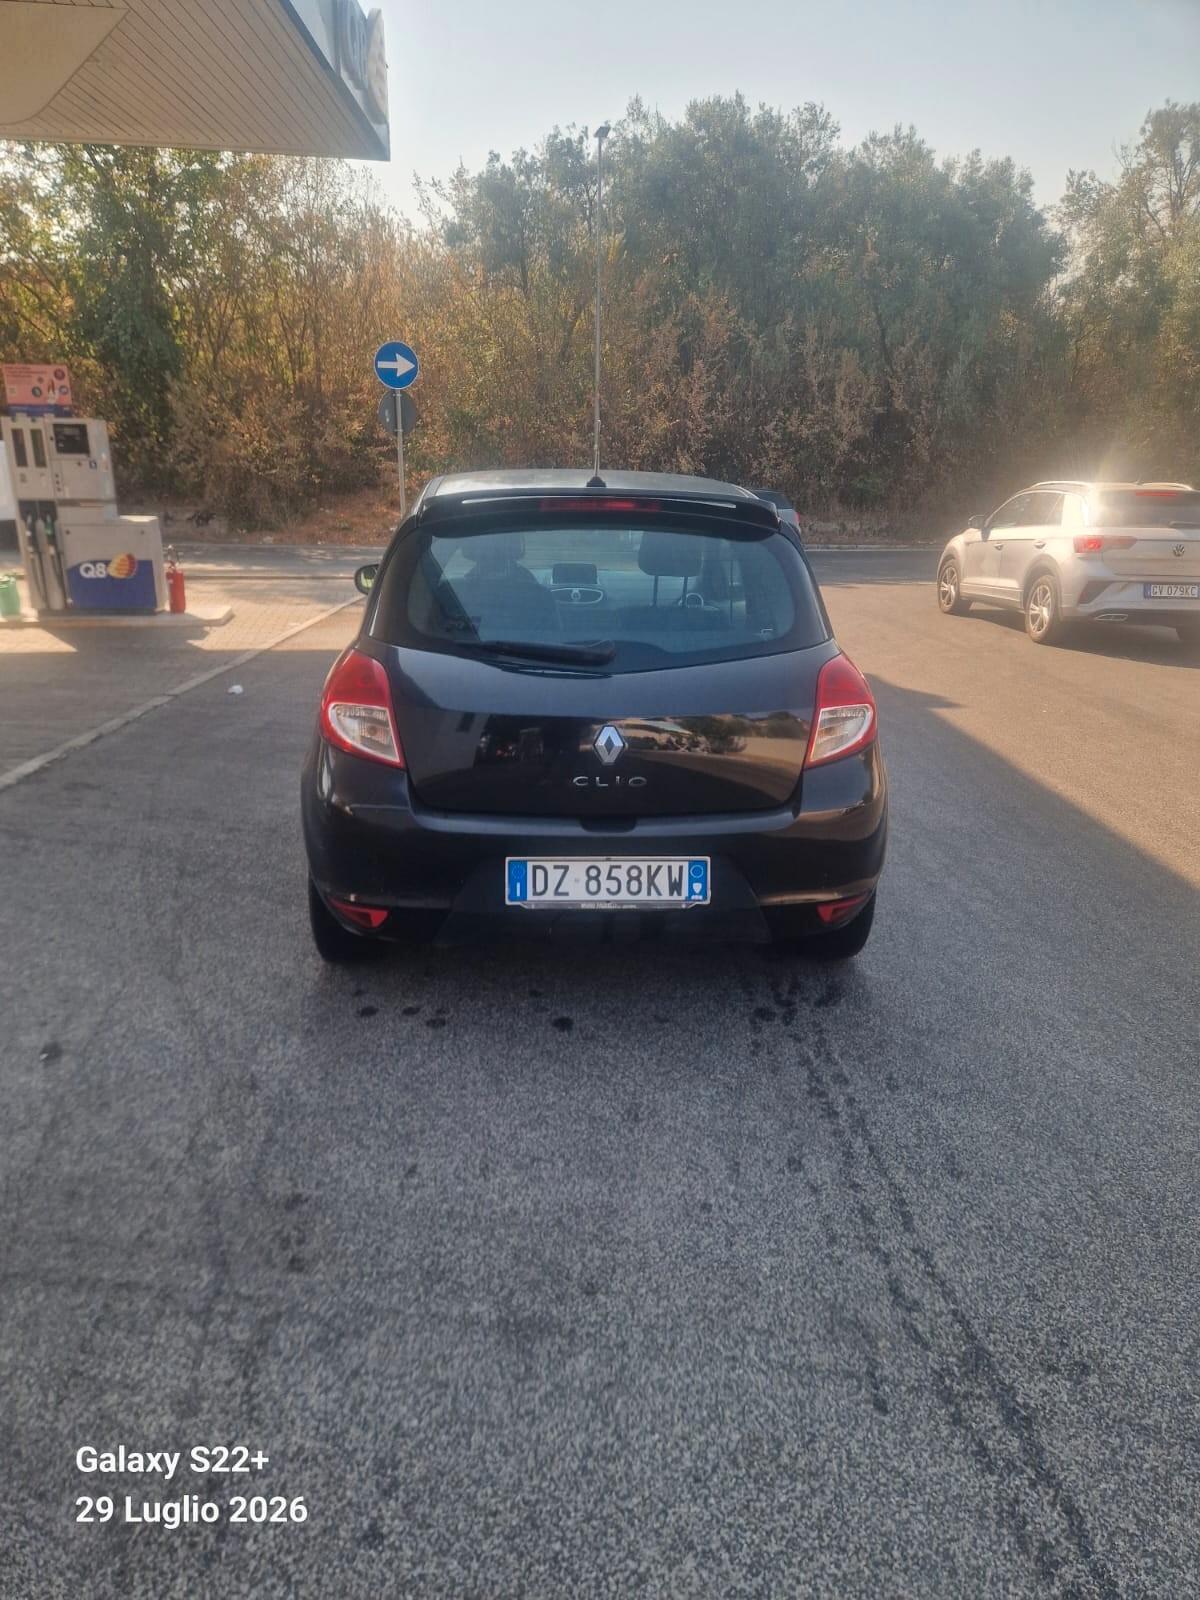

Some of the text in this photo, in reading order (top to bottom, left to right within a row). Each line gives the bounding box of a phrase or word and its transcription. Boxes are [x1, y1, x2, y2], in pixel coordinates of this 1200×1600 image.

[80, 562, 106, 578] Q8
[572, 775, 647, 787] CLIO
[531, 864, 684, 897] DZ 858KW
